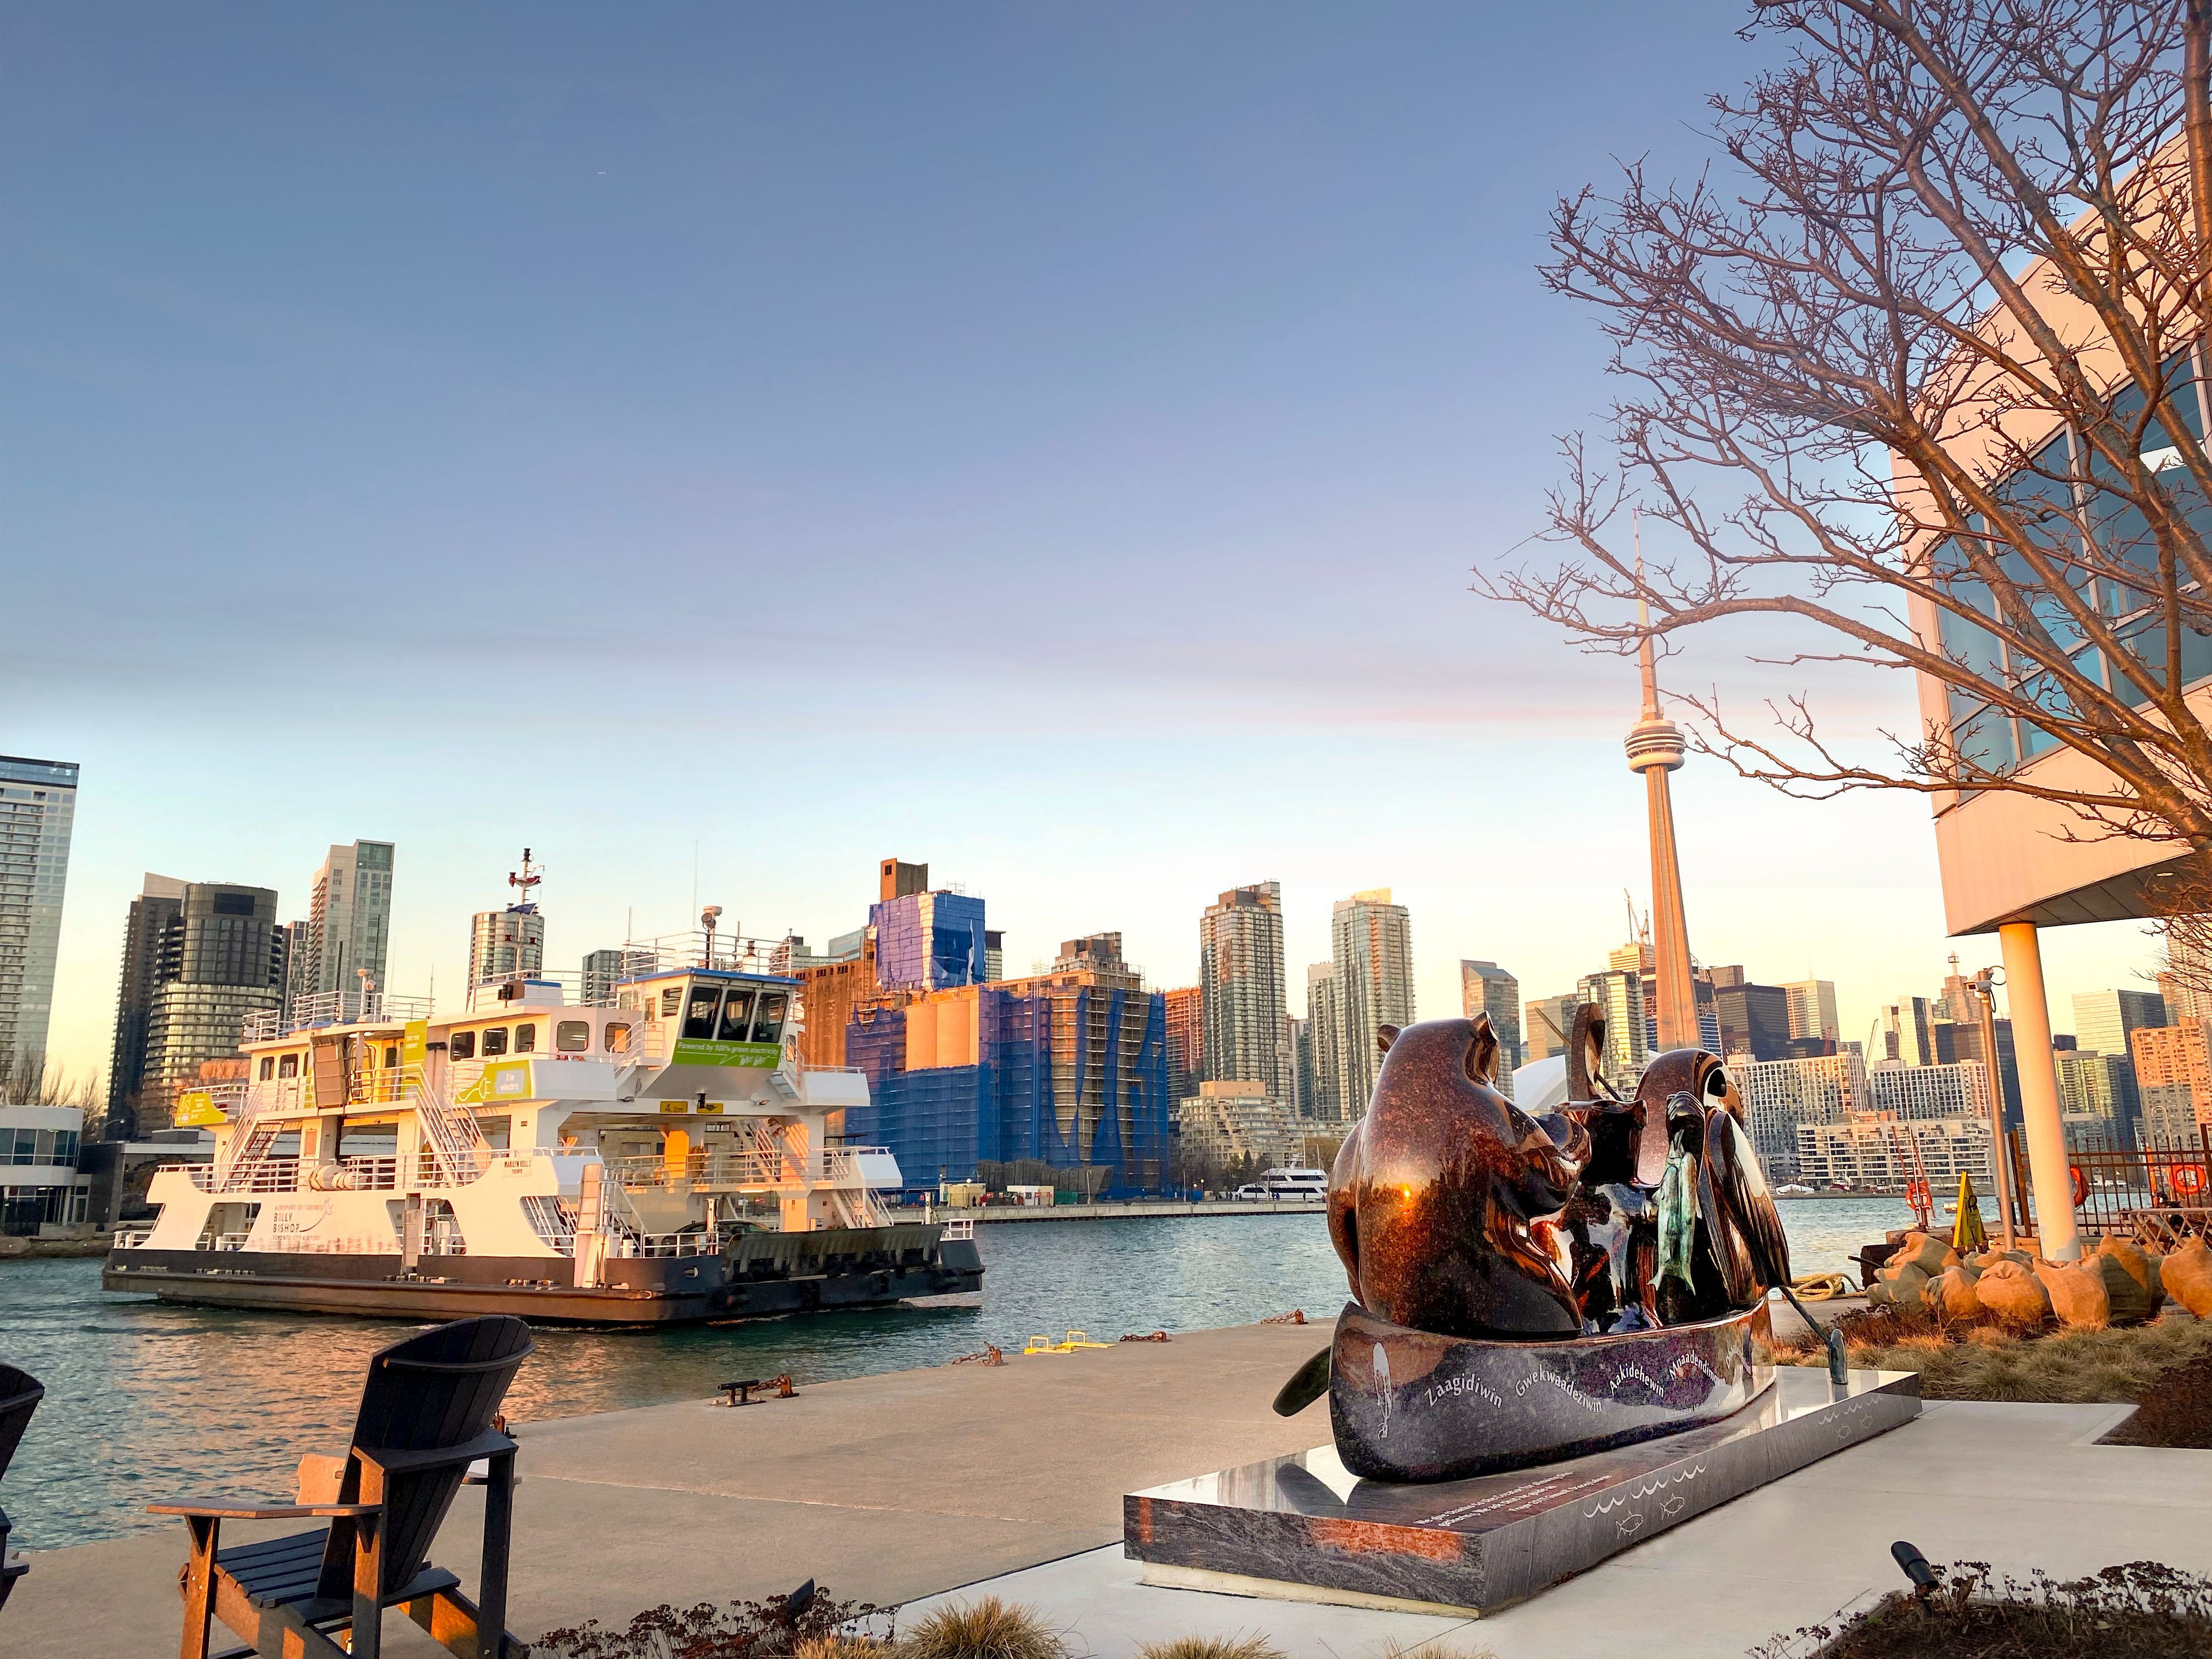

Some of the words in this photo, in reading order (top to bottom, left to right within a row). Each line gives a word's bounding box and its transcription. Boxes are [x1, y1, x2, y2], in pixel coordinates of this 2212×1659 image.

[677, 1042, 705, 1050] Powered
[274, 1212, 293, 1222] BILLY
[273, 1223, 300, 1233] BISHOP
[1424, 1372, 1503, 1409] Zaagidiwin
[1515, 1363, 1602, 1413] Gwekwaadeziwin
[1609, 1361, 1664, 1398] Aakidehewin
